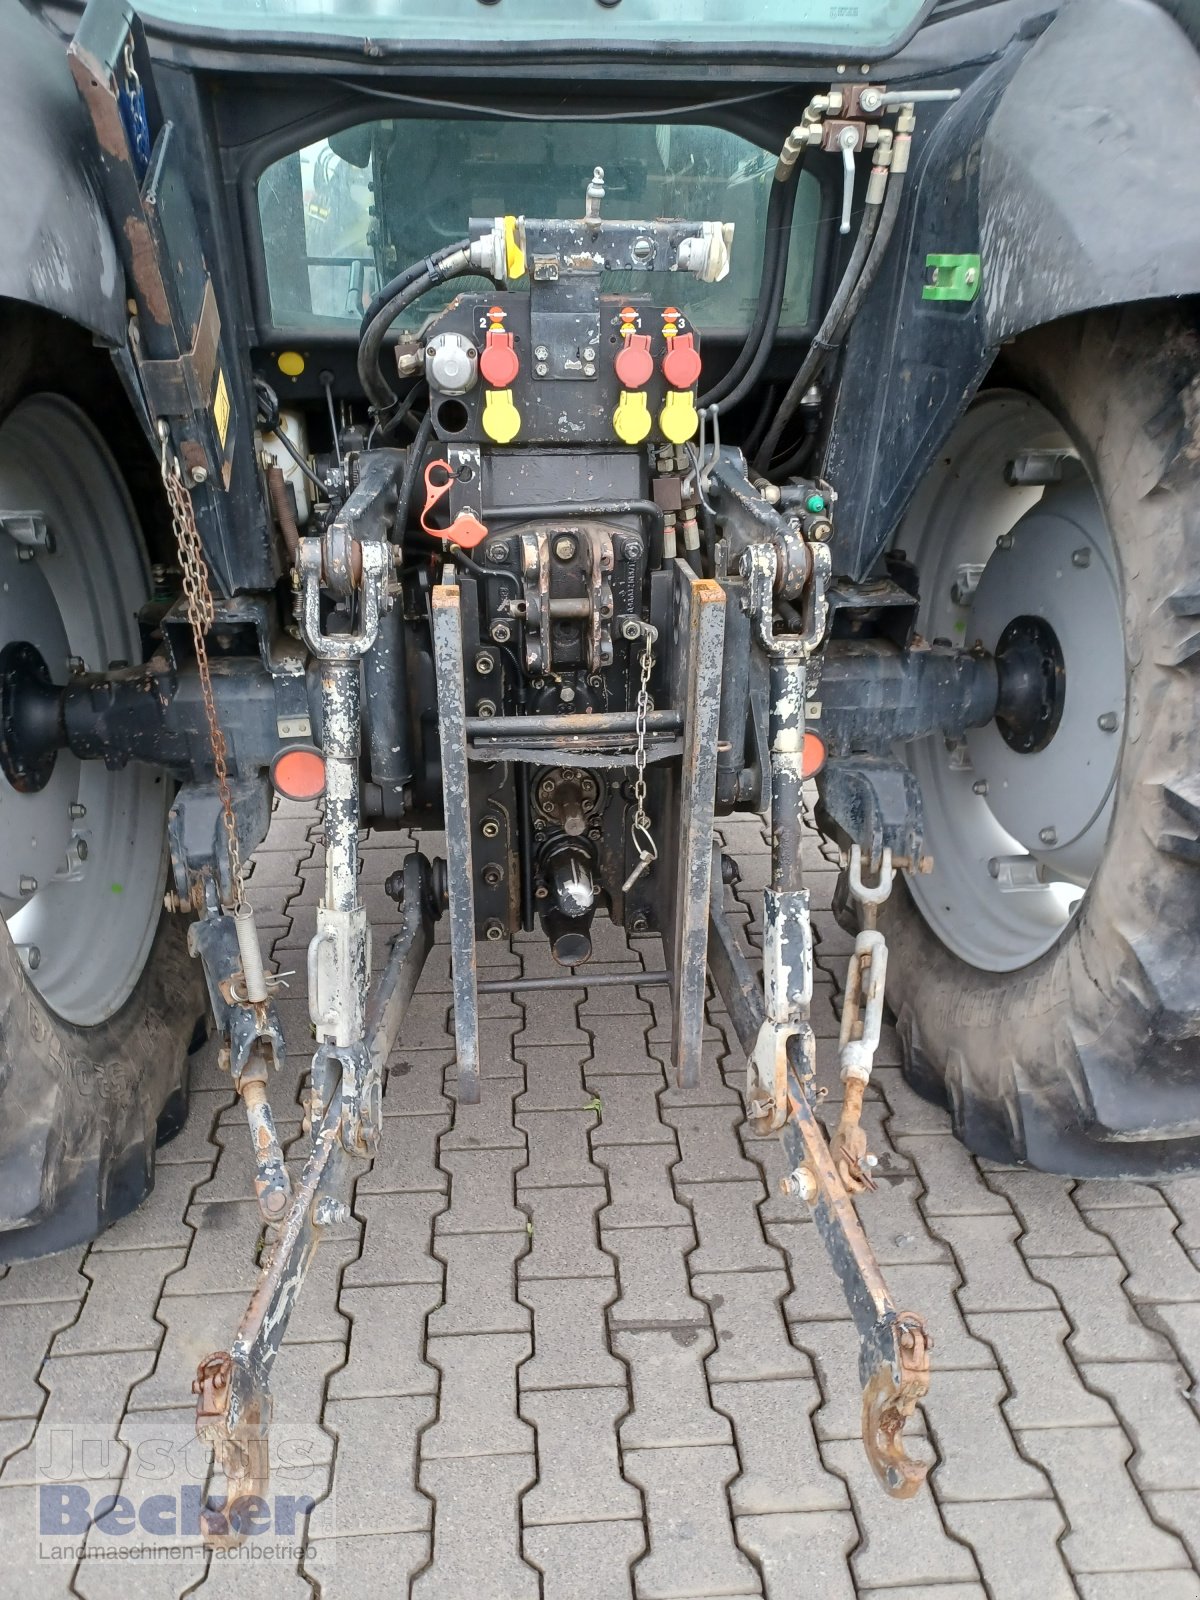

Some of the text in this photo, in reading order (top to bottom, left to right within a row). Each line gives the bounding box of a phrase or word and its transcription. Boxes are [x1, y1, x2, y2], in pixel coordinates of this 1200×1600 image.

[479, 318, 487, 329] 2
[636, 318, 642, 329] 1
[678, 318, 686, 329] 3
